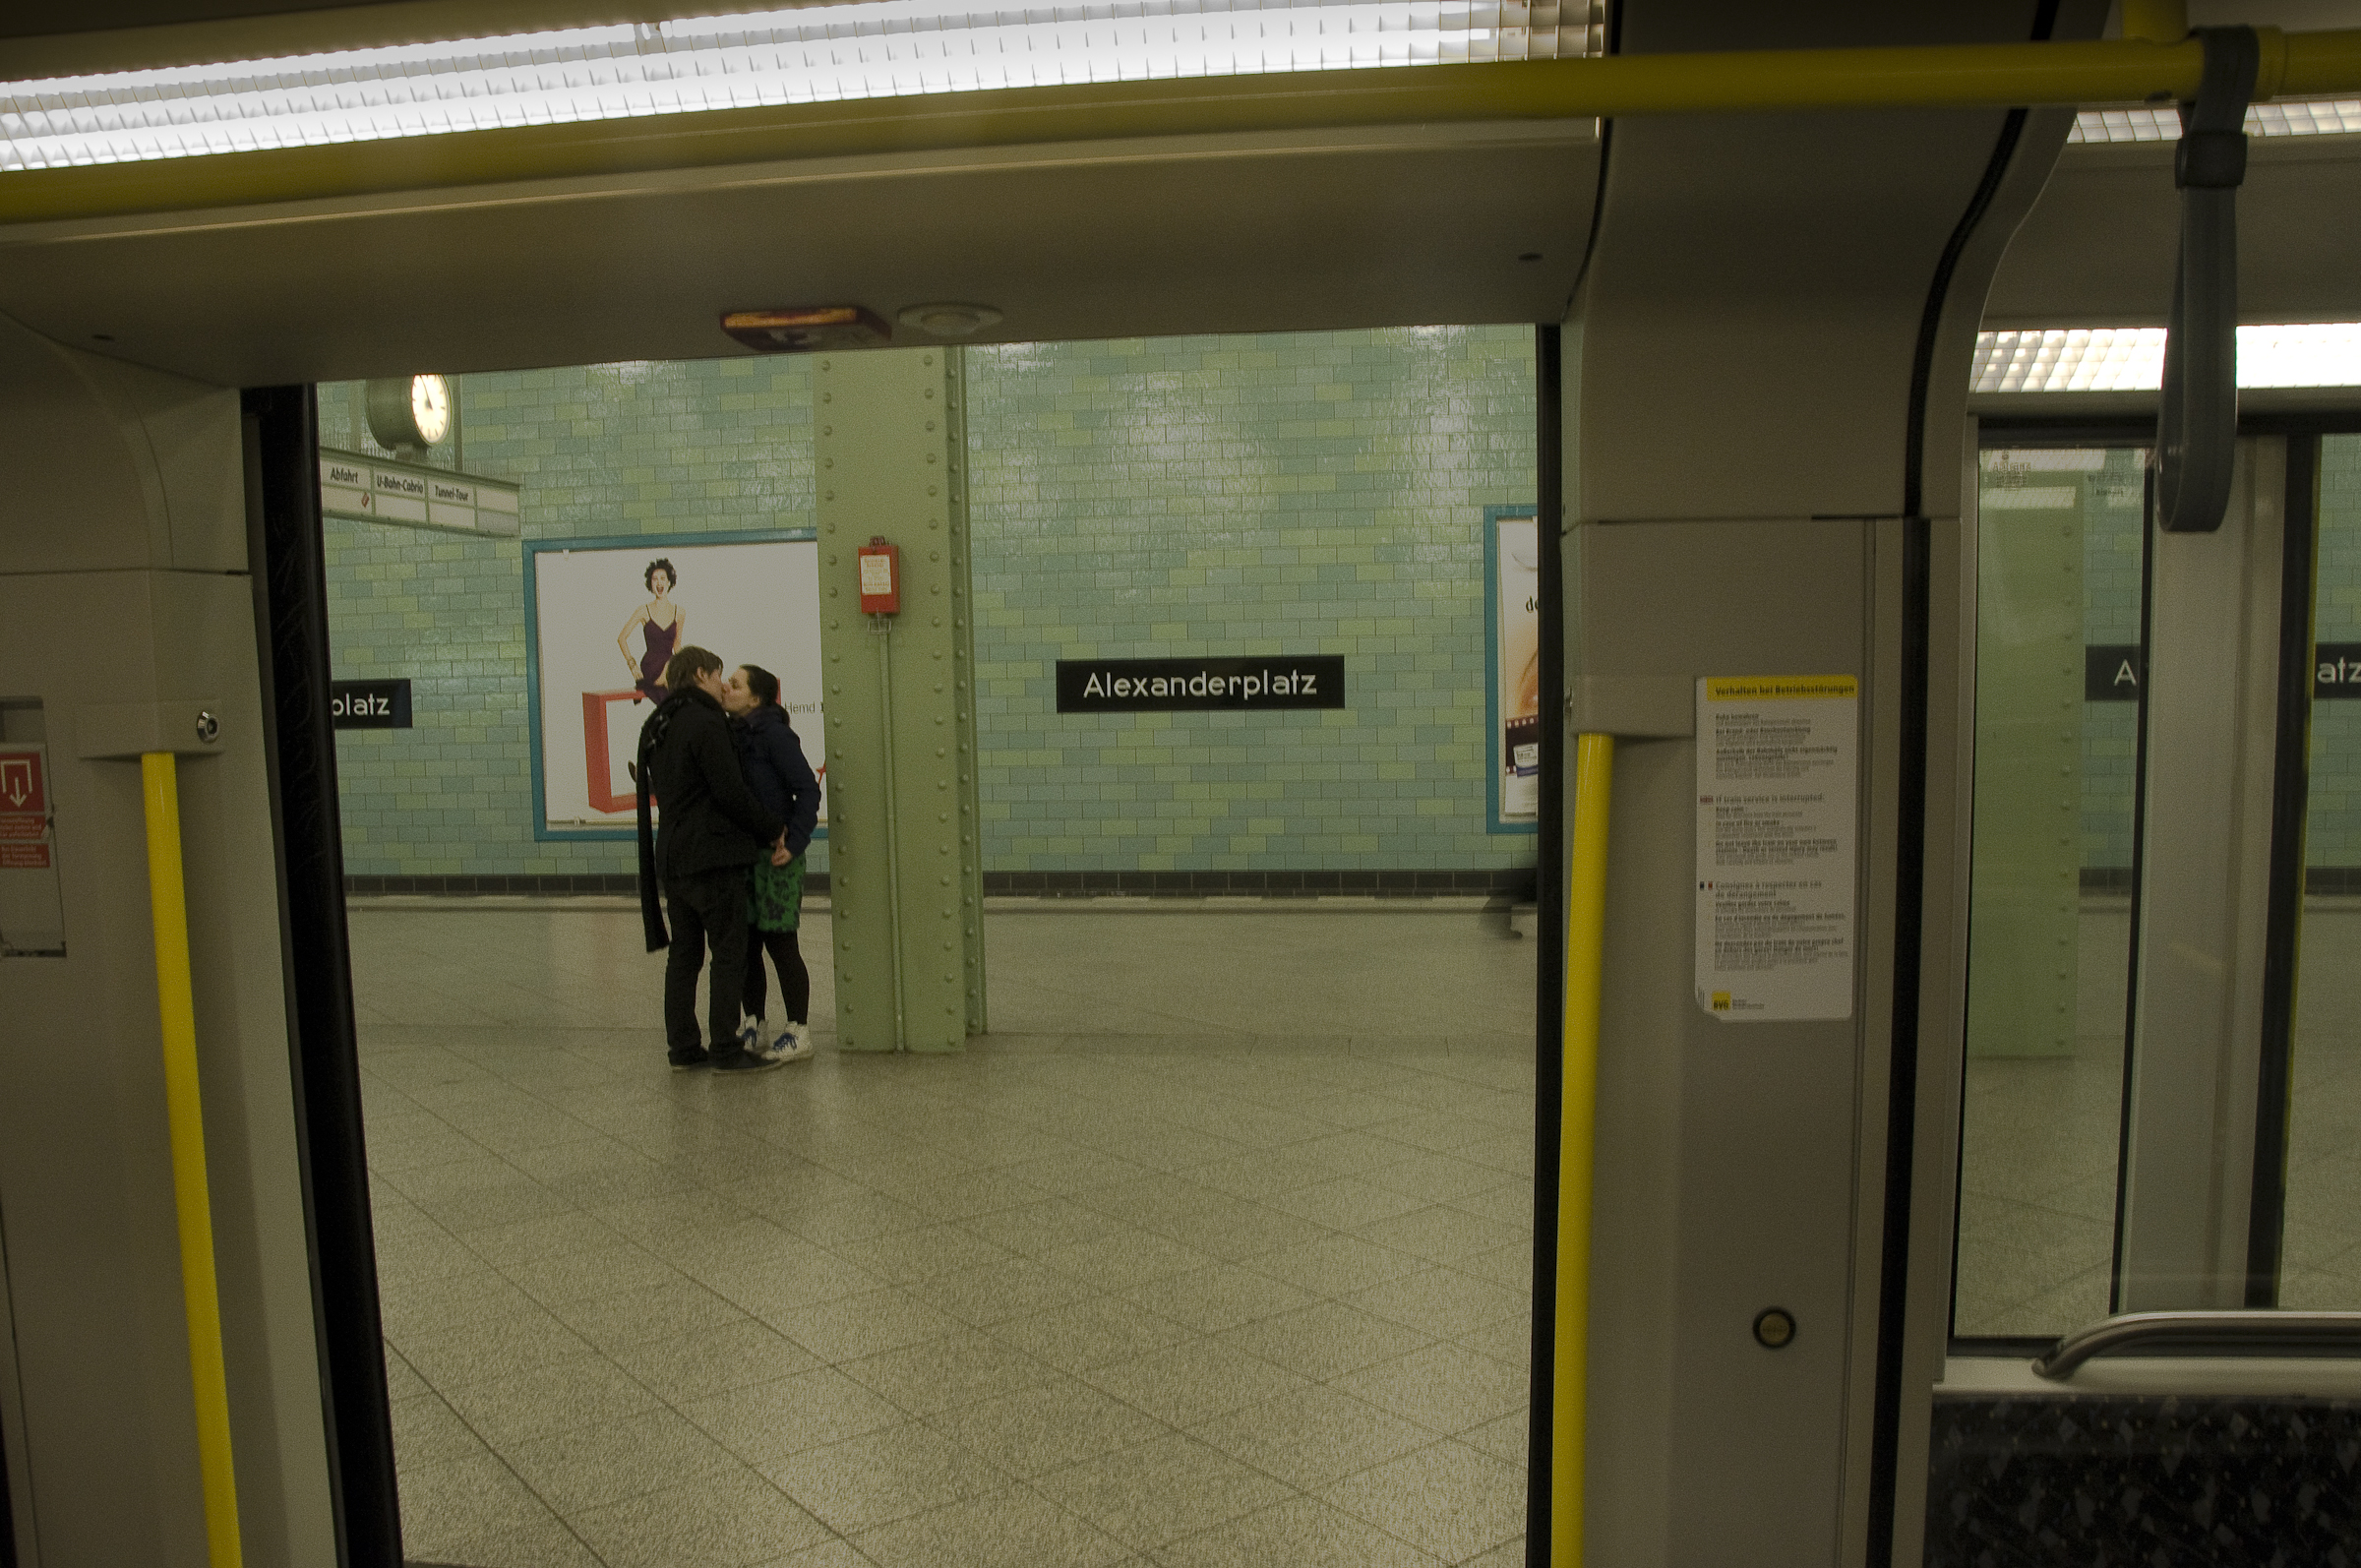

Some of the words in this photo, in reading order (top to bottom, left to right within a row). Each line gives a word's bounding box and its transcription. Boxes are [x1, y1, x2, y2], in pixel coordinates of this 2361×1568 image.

[331, 467, 359, 484] Abfahrt
[377, 475, 424, 495] U-Bahn-Cabrio
[435, 485, 469, 502] Tunnel-Tour
[1082, 669, 1316, 701] Alexanderplatz
[1716, 686, 1757, 695] Verhalten
[1759, 685, 1773, 694] bei
[1713, 999, 1728, 1010] BVG
